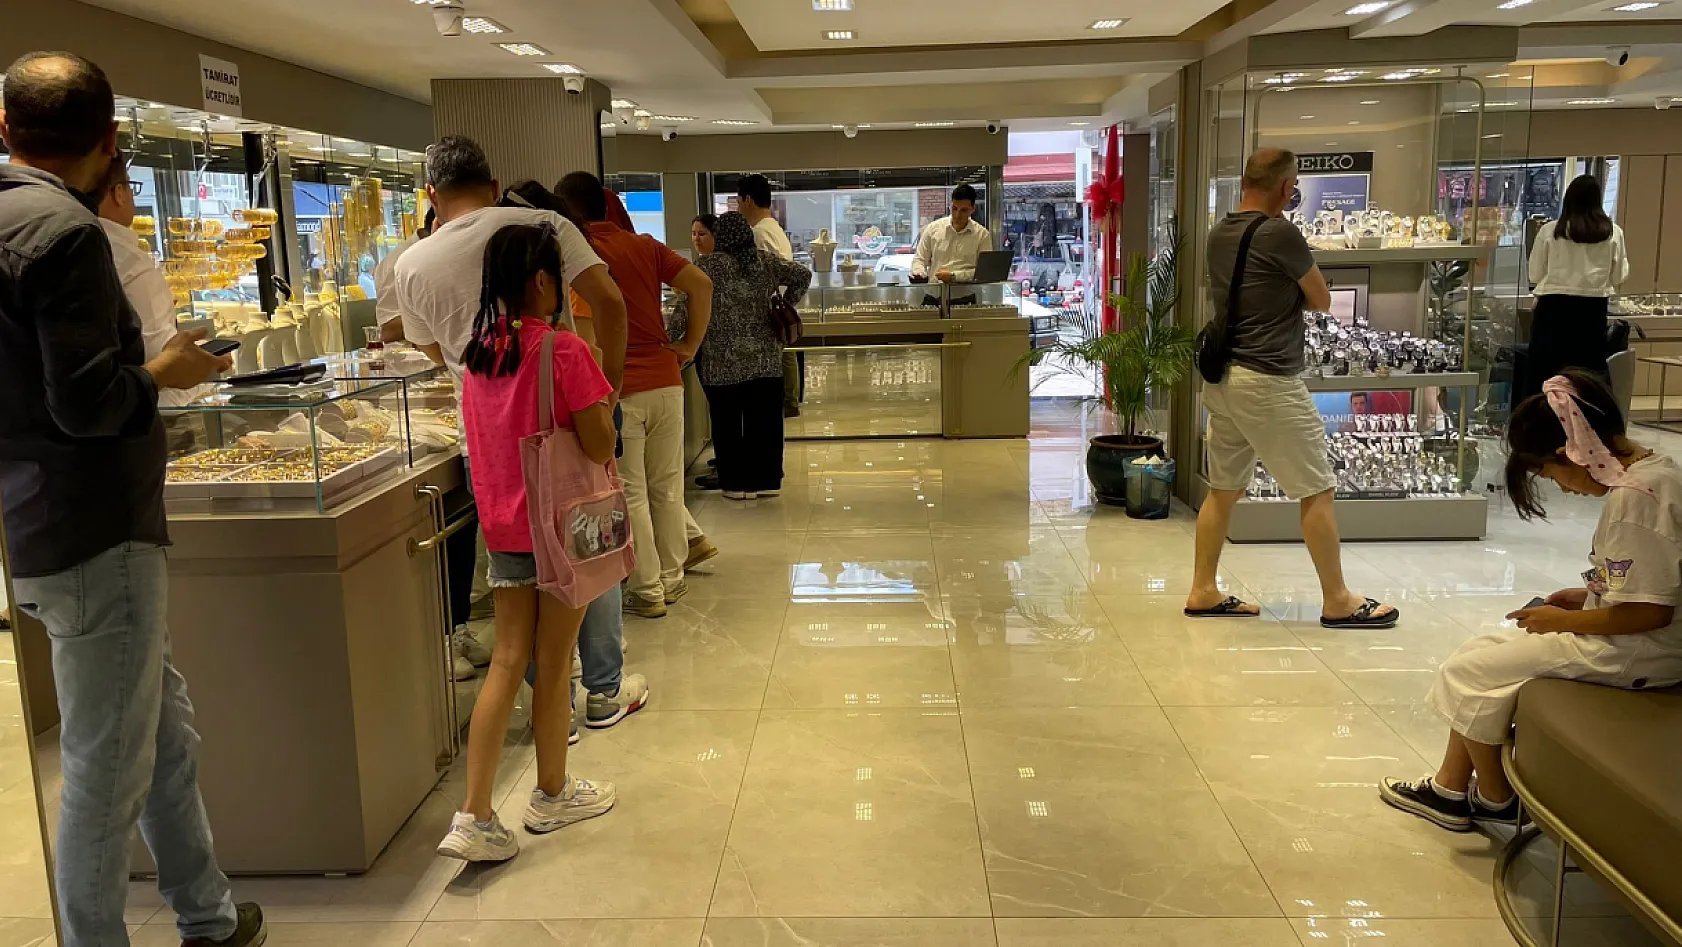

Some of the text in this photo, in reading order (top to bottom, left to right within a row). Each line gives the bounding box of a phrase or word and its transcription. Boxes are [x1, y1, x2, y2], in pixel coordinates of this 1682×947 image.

[203, 68, 238, 87] TAMİRAT
[205, 87, 240, 106] ÜCRETLİDİR
[1296, 154, 1354, 171] EIKO
[1321, 413, 1355, 423] DANIE
